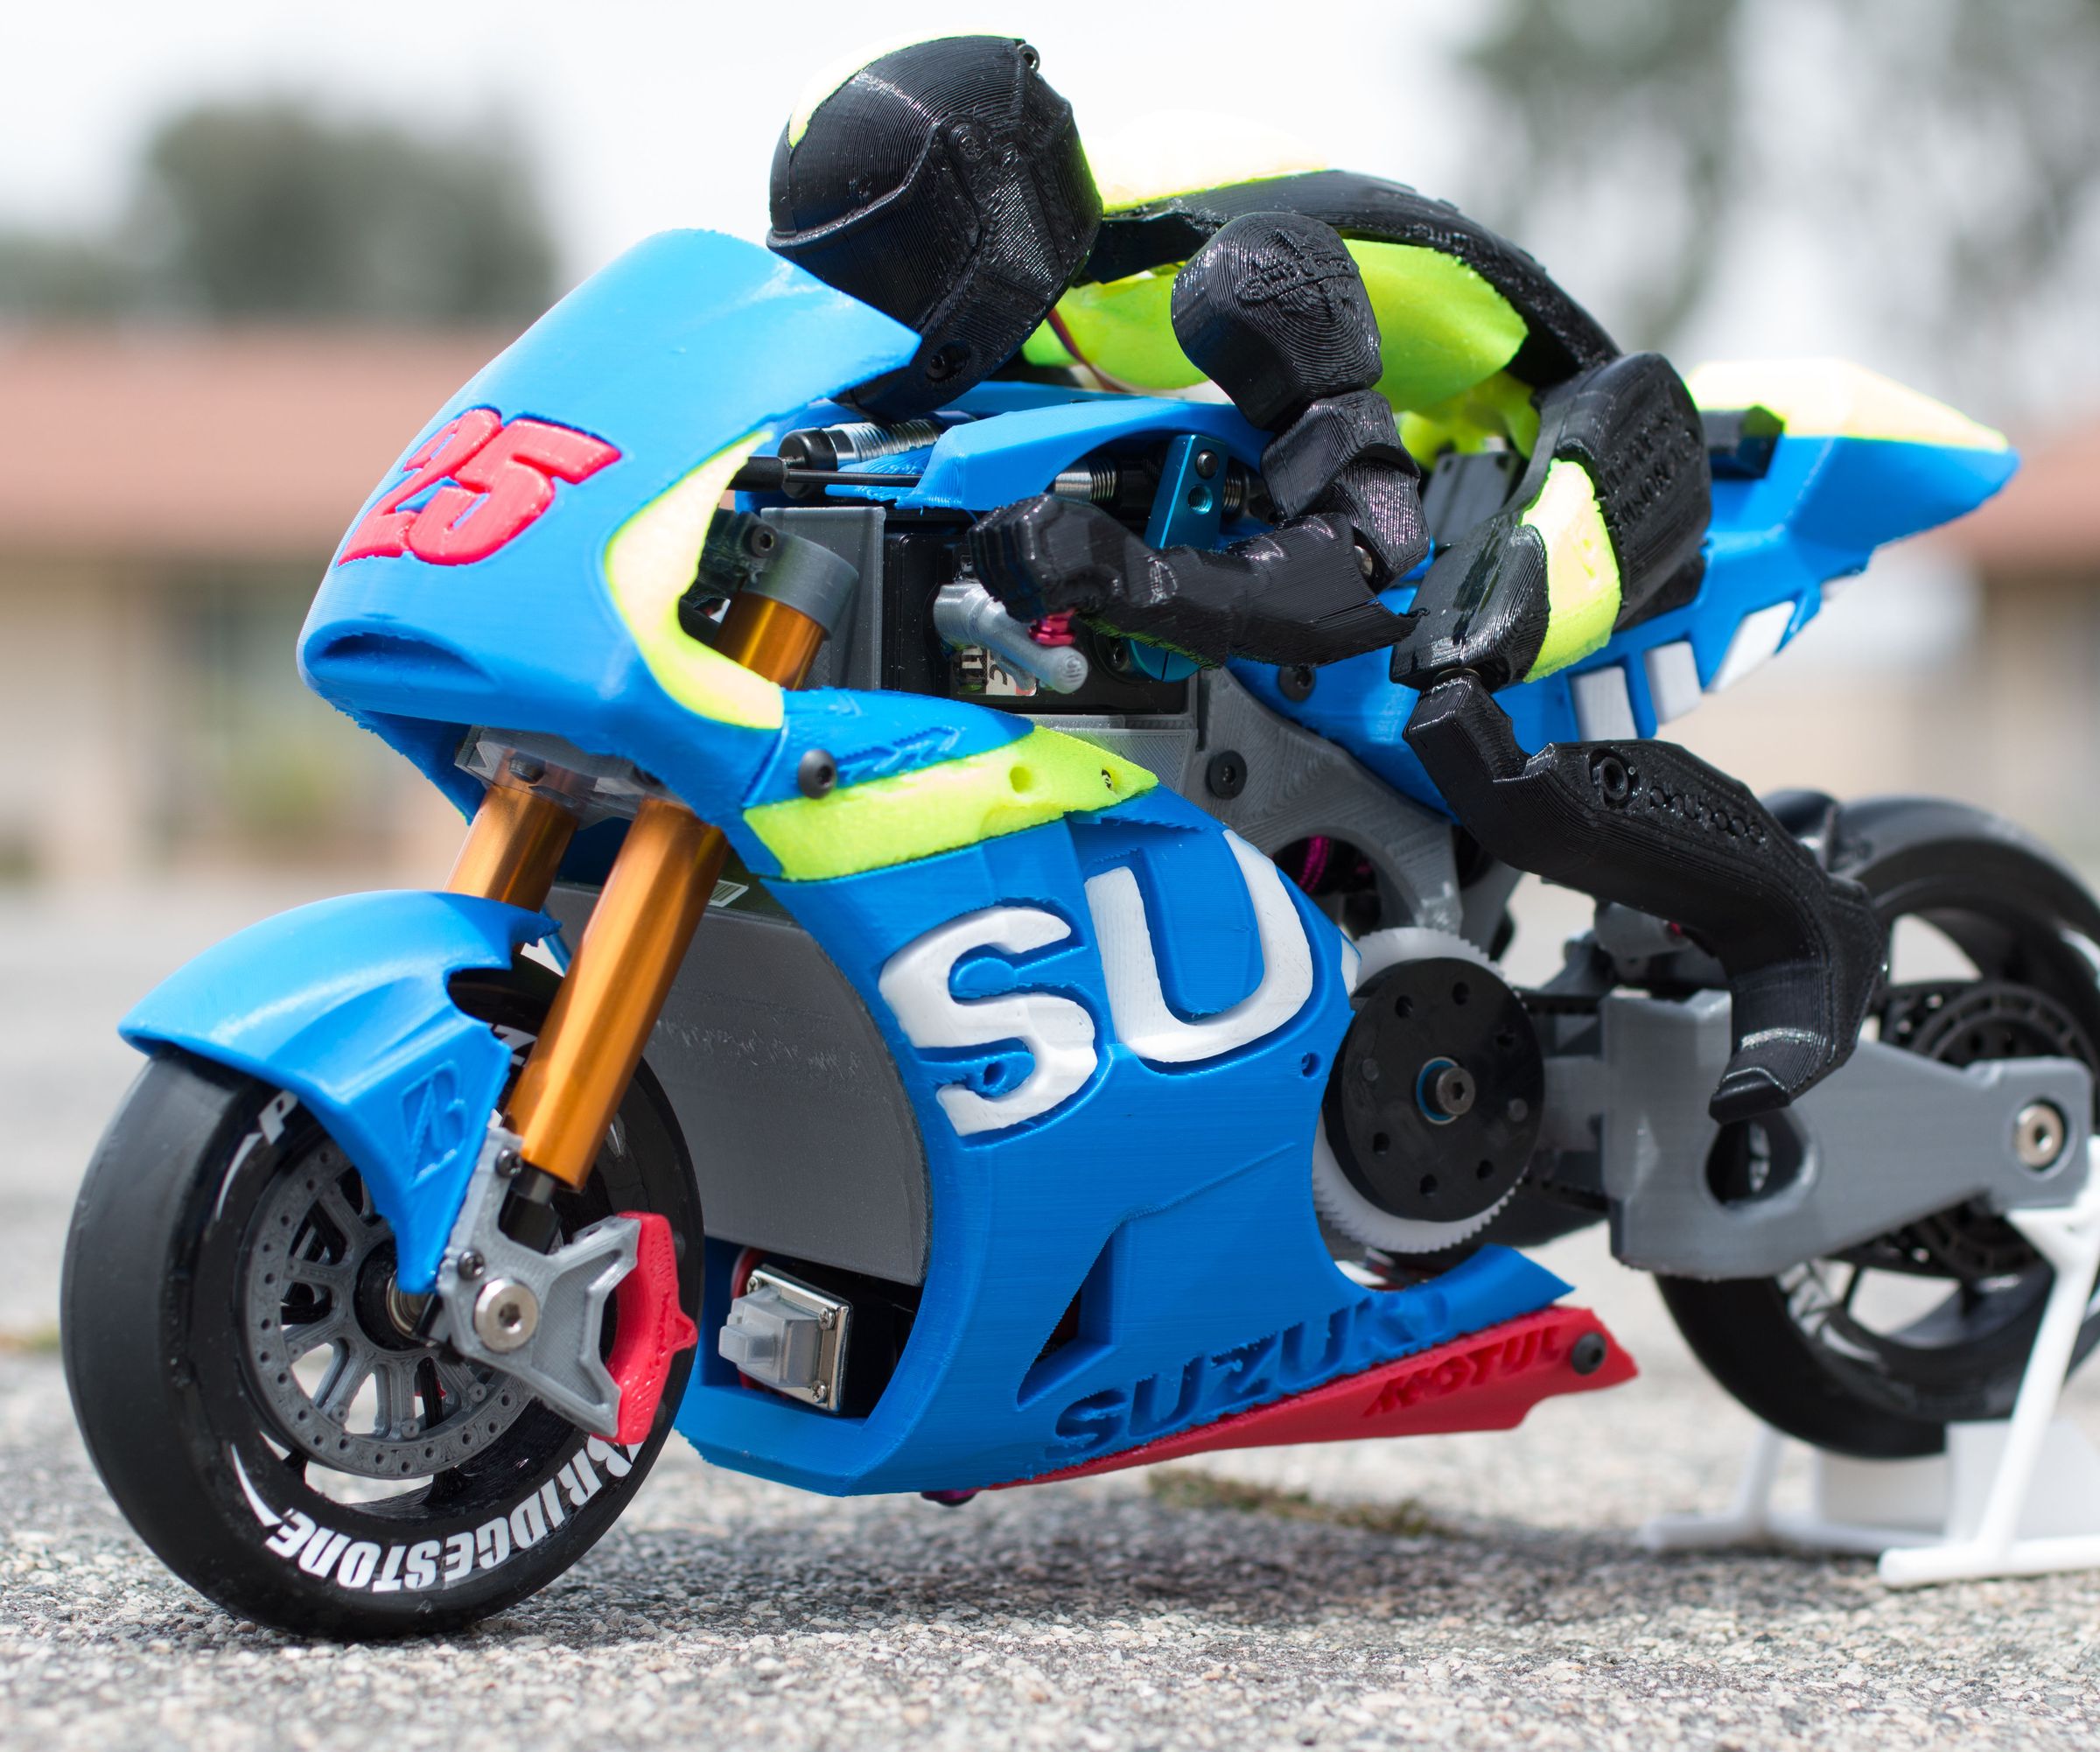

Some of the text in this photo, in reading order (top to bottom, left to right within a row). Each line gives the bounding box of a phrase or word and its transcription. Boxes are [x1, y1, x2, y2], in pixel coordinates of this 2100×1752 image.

[337, 405, 622, 566] 25
[1044, 1293, 1448, 1461] SUZUKI
[1360, 1326, 1561, 1419] MOTUL
[266, 1433, 645, 1593] BRIDGESTONE
